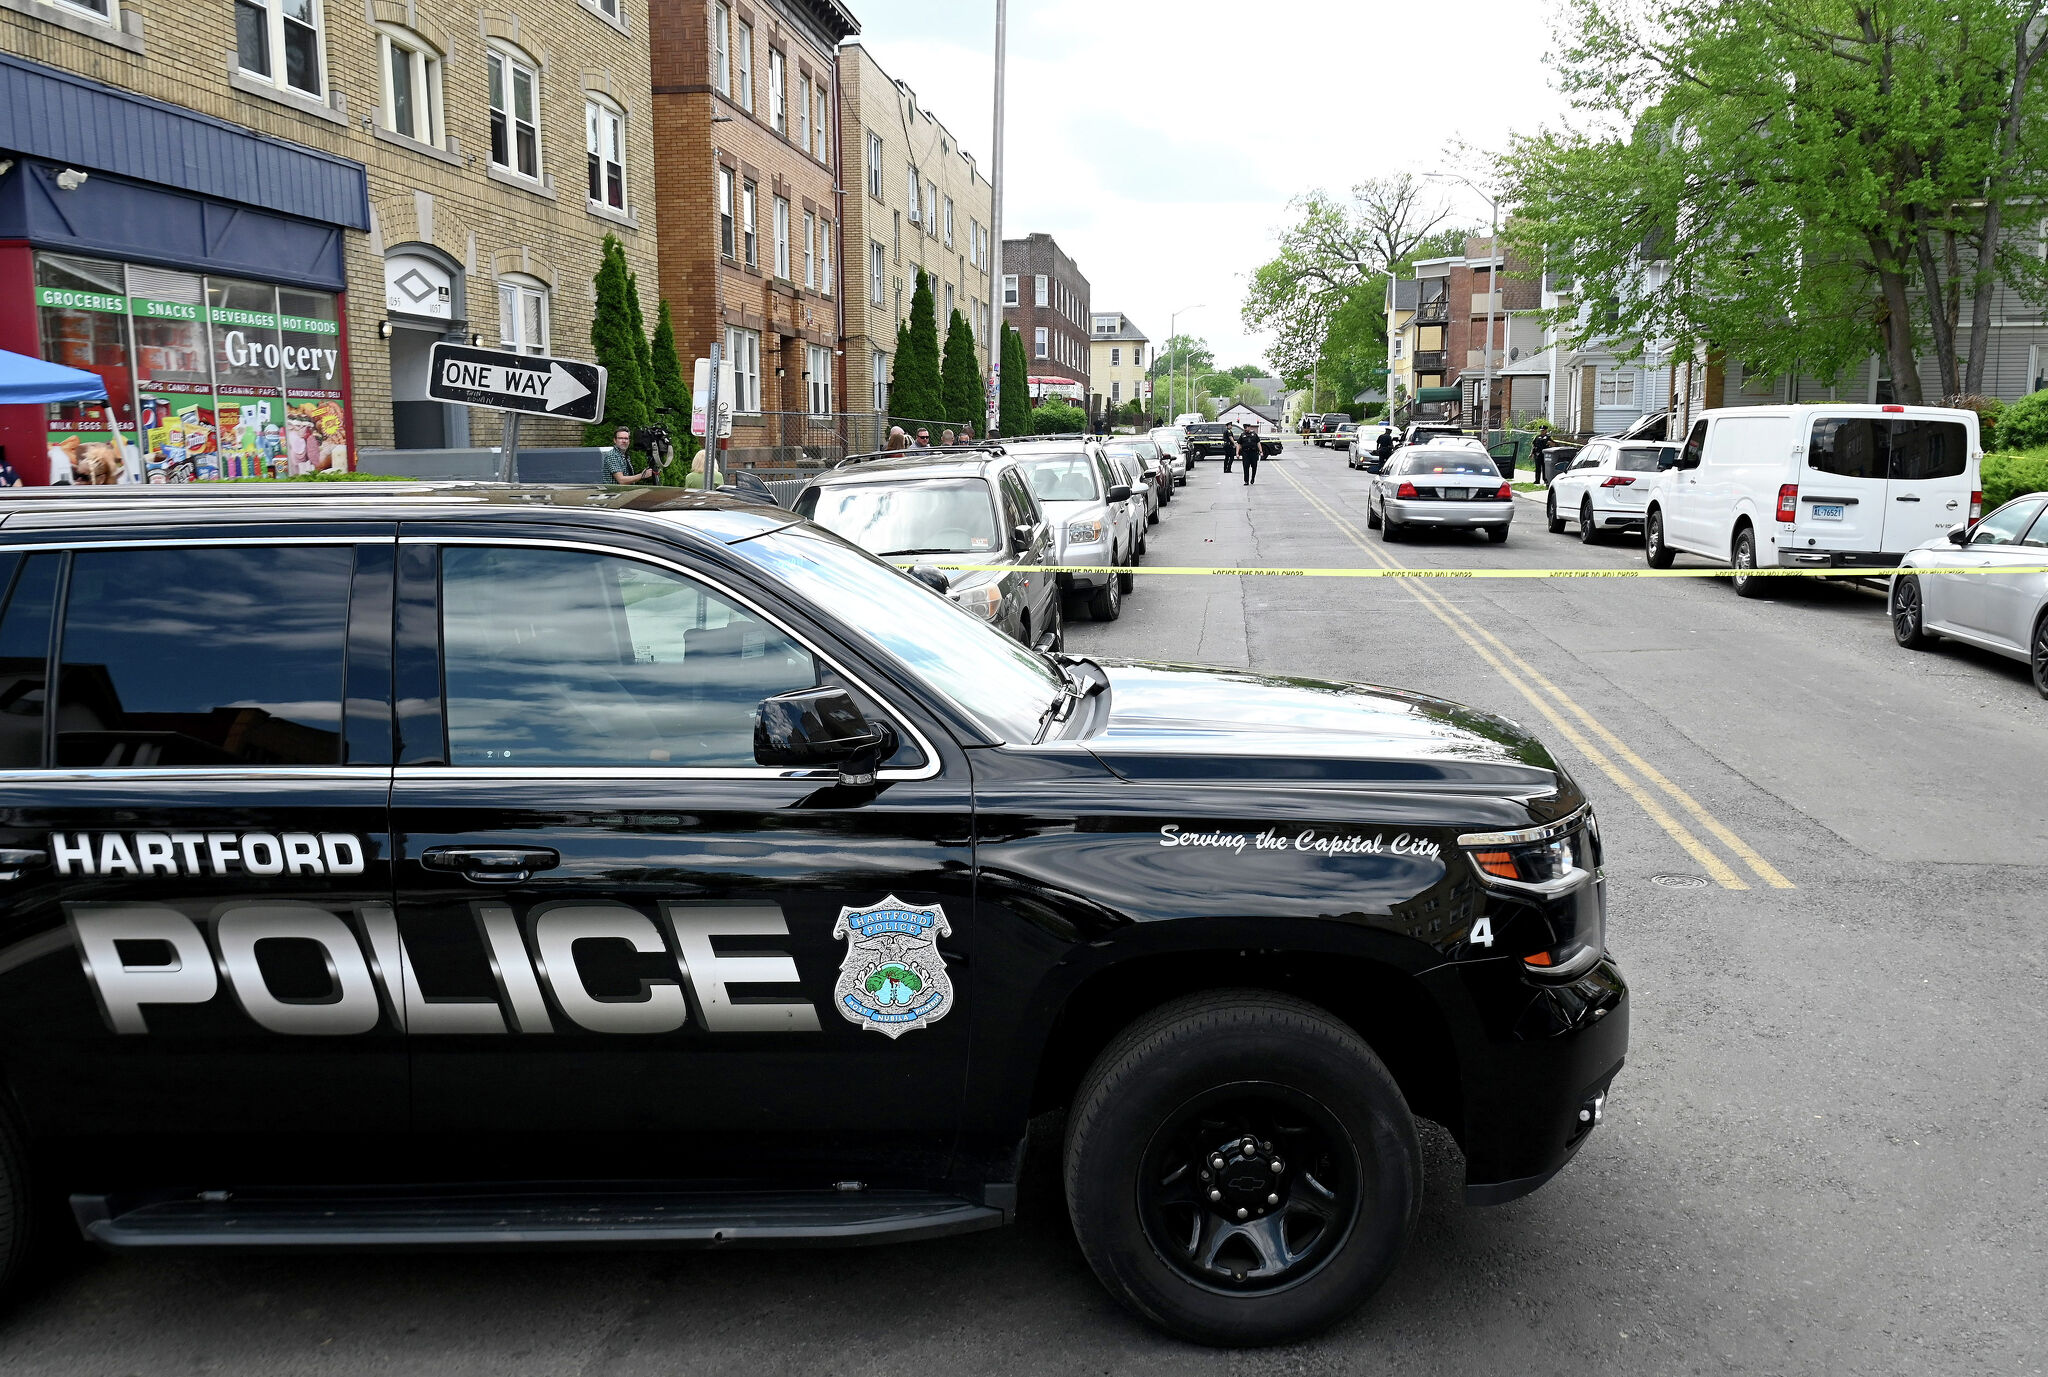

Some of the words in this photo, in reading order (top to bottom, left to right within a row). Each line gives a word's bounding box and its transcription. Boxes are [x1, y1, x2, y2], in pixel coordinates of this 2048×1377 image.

[42, 290, 123, 311] GROCERIES
[147, 302, 197, 319] SNACKS
[212, 309, 275, 327] BEVERAGES
[282, 317, 302, 330] HOT
[304, 319, 336, 334] FOODS
[225, 330, 338, 380] Grocery
[446, 362, 492, 389] ONE
[505, 370, 552, 396] WAY
[168, 383, 191, 392] CANDY
[194, 385, 210, 393] GUM
[219, 386, 254, 396] CLEANING
[258, 388, 278, 396] PAPE
[287, 389, 326, 399] SANDWICHES
[328, 391, 341, 399] DELI
[49, 421, 73, 430] MILK
[78, 421, 101, 430] EGGS
[107, 421, 135, 430] BEAD
[1160, 824, 1248, 856] Serving
[1255, 826, 1289, 850] the
[1294, 828, 1384, 858] Capital
[1390, 832, 1441, 862] City
[52, 832, 365, 875] HARTFORD
[856, 911, 928, 926] HARTFORD
[867, 922, 917, 934] POLICE
[1469, 917, 1494, 948] 4
[66, 903, 823, 1035] POLICE
